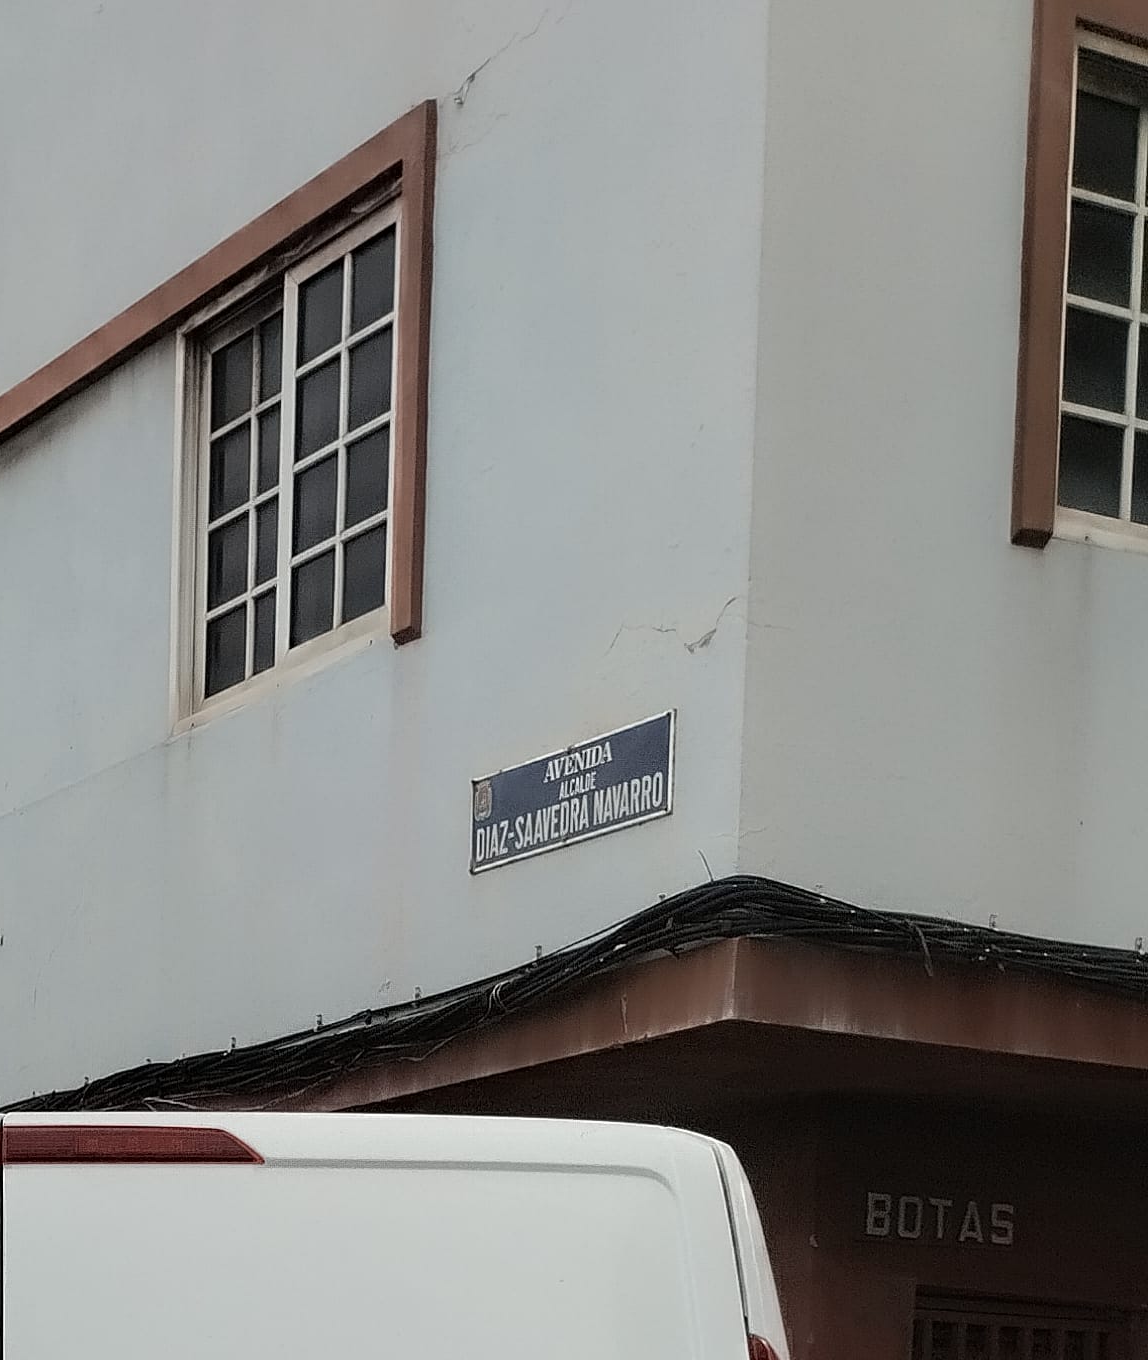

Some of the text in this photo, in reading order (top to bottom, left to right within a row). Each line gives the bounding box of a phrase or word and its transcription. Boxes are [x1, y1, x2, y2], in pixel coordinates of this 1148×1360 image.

[543, 741, 612, 783] AVENIDA
[559, 771, 597, 800] ALCALDE
[475, 771, 664, 862] DIAZ-SAAVEDRA NAVARRO
[866, 1191, 1014, 1245] BOTAS
